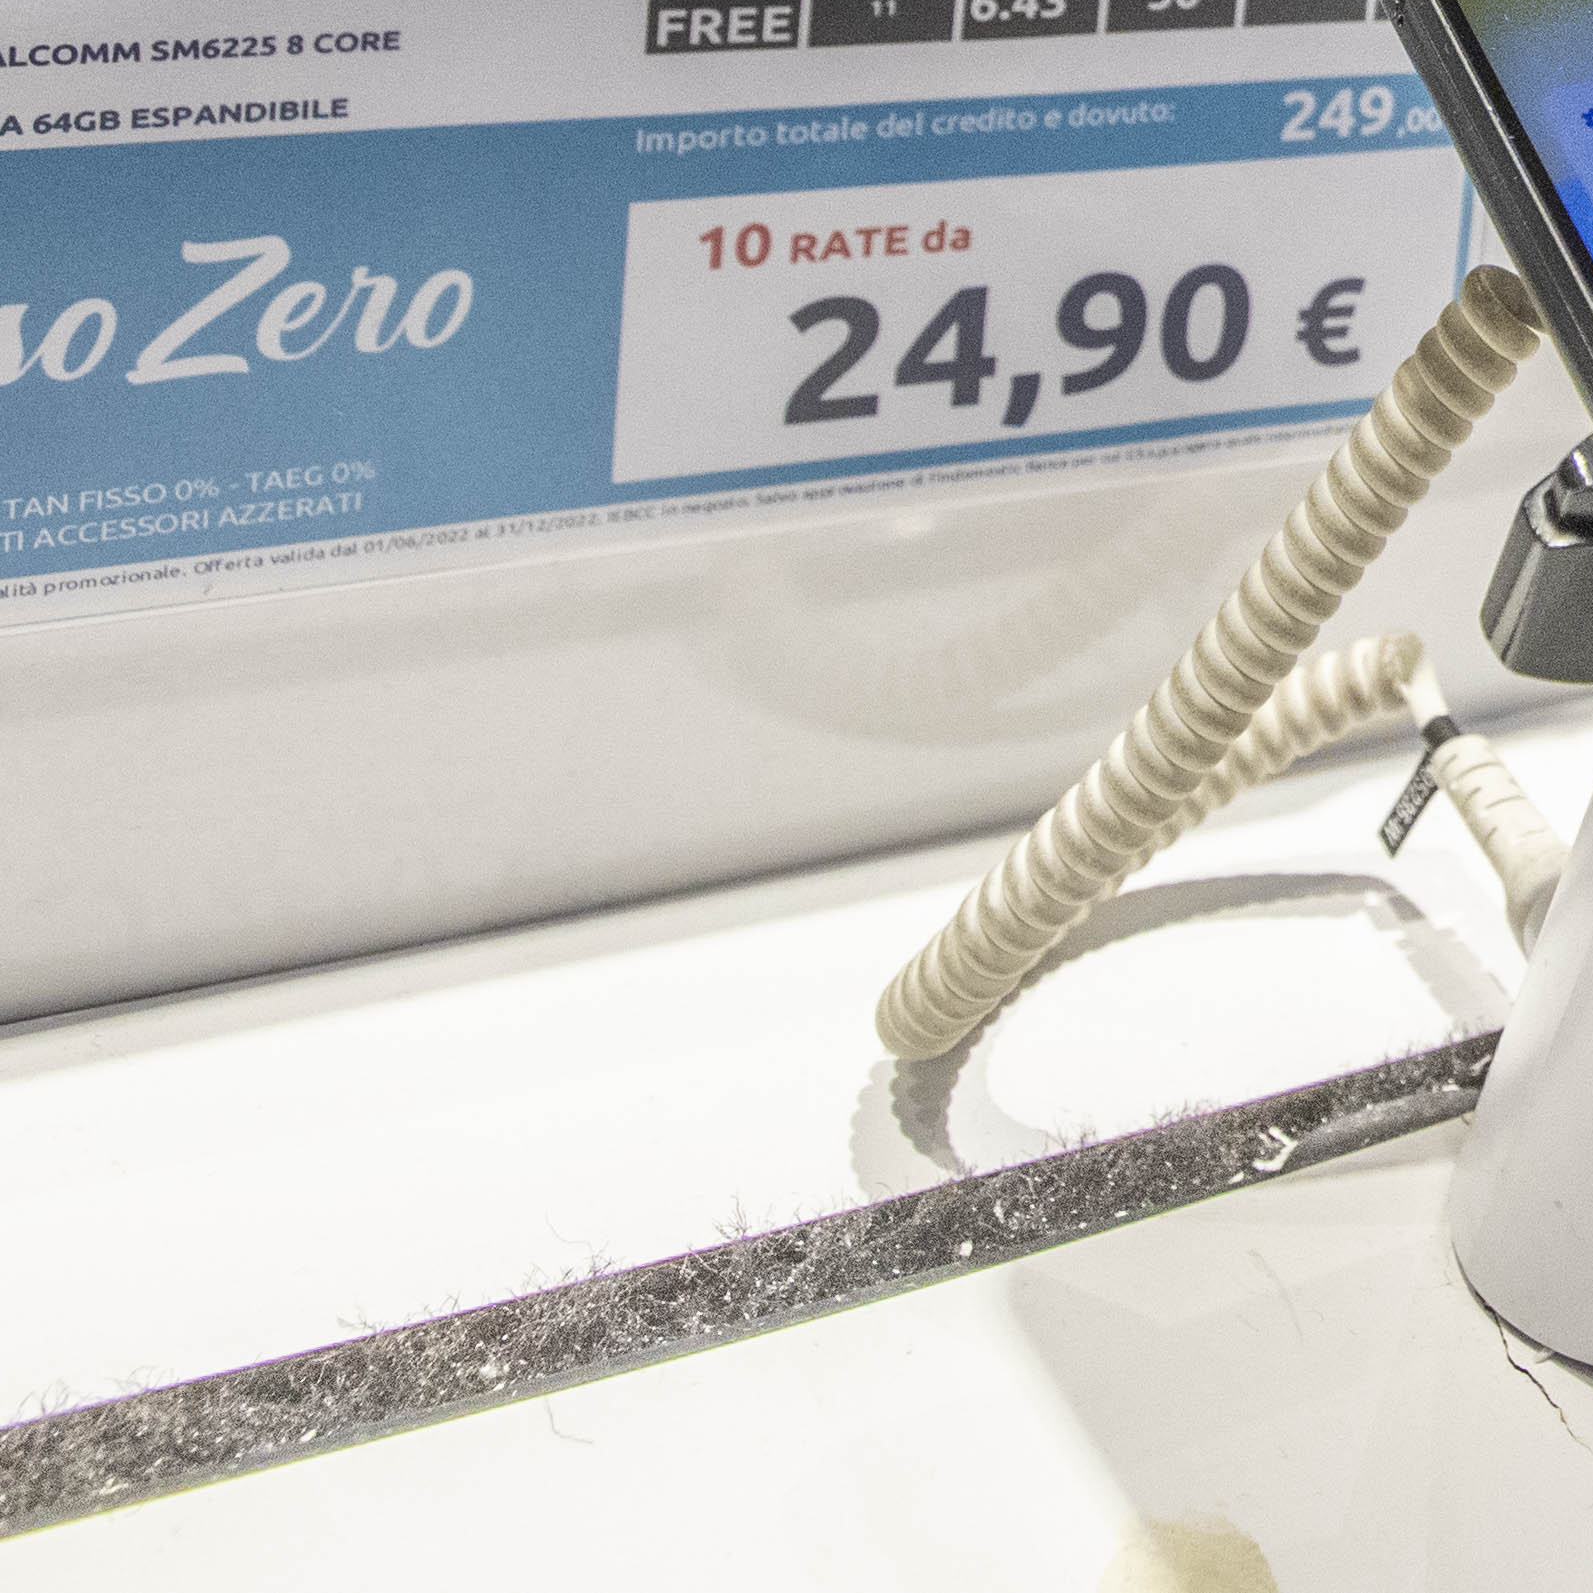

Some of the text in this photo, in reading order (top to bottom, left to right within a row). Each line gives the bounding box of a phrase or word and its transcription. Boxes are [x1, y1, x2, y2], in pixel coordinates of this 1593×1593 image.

[655, 5, 794, 49] FREE
[871, 0, 898, 18] 11
[150, 34, 278, 64] SM6225
[287, 34, 305, 58] 8
[313, 30, 403, 56] CORE
[32, 109, 121, 136] 64GB
[130, 97, 350, 131] ESPANDIBILE
[636, 101, 1178, 156] Importo totale del credito e dovuto:
[697, 219, 974, 271] 10 RATE da
[125, 234, 474, 386] Zero
[783, 262, 1367, 428] 24,90 €
[4, 492, 69, 521] TAN
[79, 481, 167, 512] FISSO
[174, 476, 220, 502] 0%
[247, 464, 324, 494] TAEG
[331, 459, 377, 483] 0%
[33, 510, 210, 549] ACCESSORI
[218, 491, 364, 528] AZZERATI
[44, 564, 188, 597] promozionale.
[193, 555, 265, 575] Offerta
[270, 546, 327, 566] valida
[330, 542, 359, 559] dal
